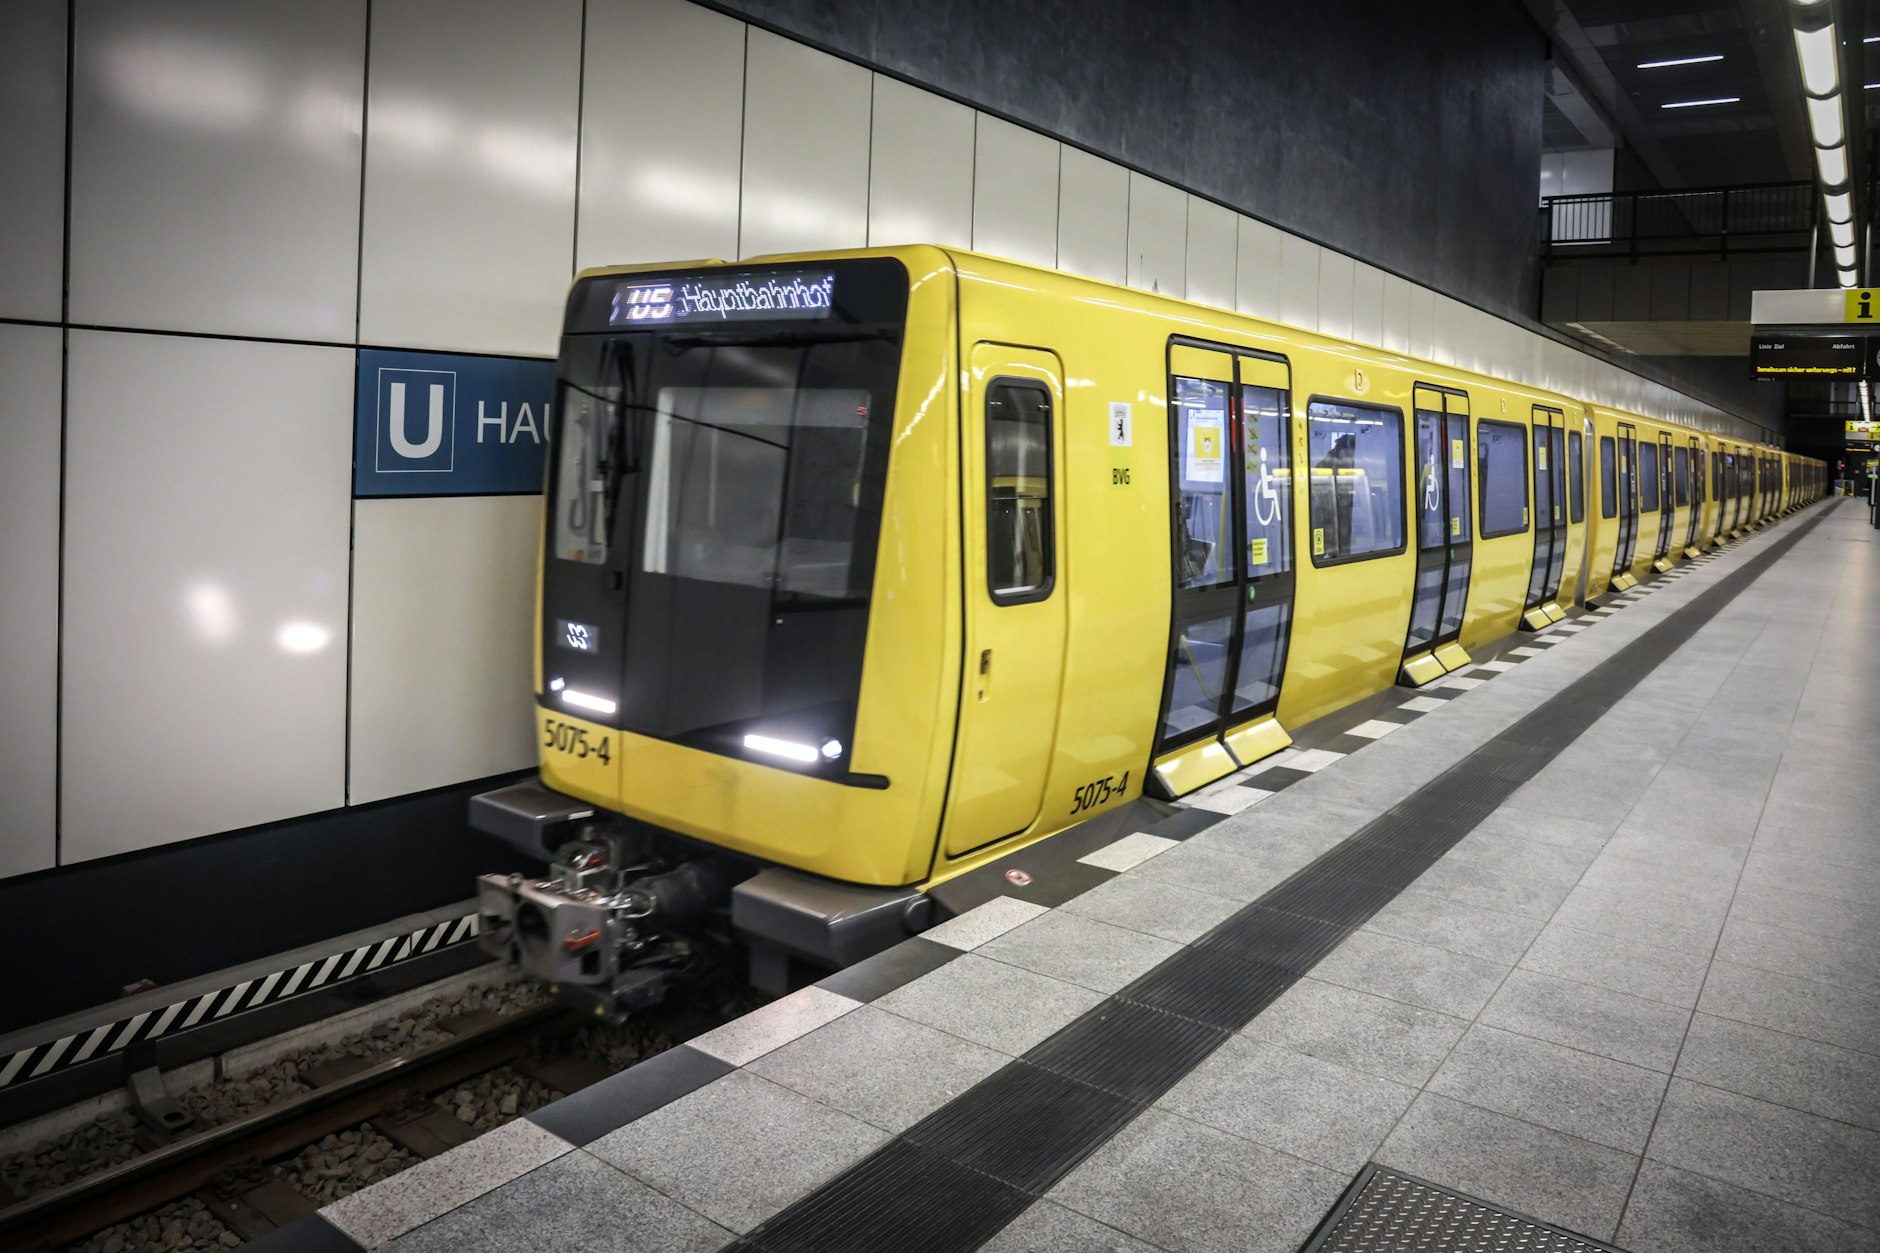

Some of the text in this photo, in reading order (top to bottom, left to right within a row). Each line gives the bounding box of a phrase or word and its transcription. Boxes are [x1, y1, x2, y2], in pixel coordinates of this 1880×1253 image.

[681, 275, 834, 319] Hauptbahnhof
[389, 382, 445, 459] U
[1112, 468, 1131, 485] BVG
[544, 718, 612, 767] 5075-4
[1070, 770, 1129, 815] 5075-4
